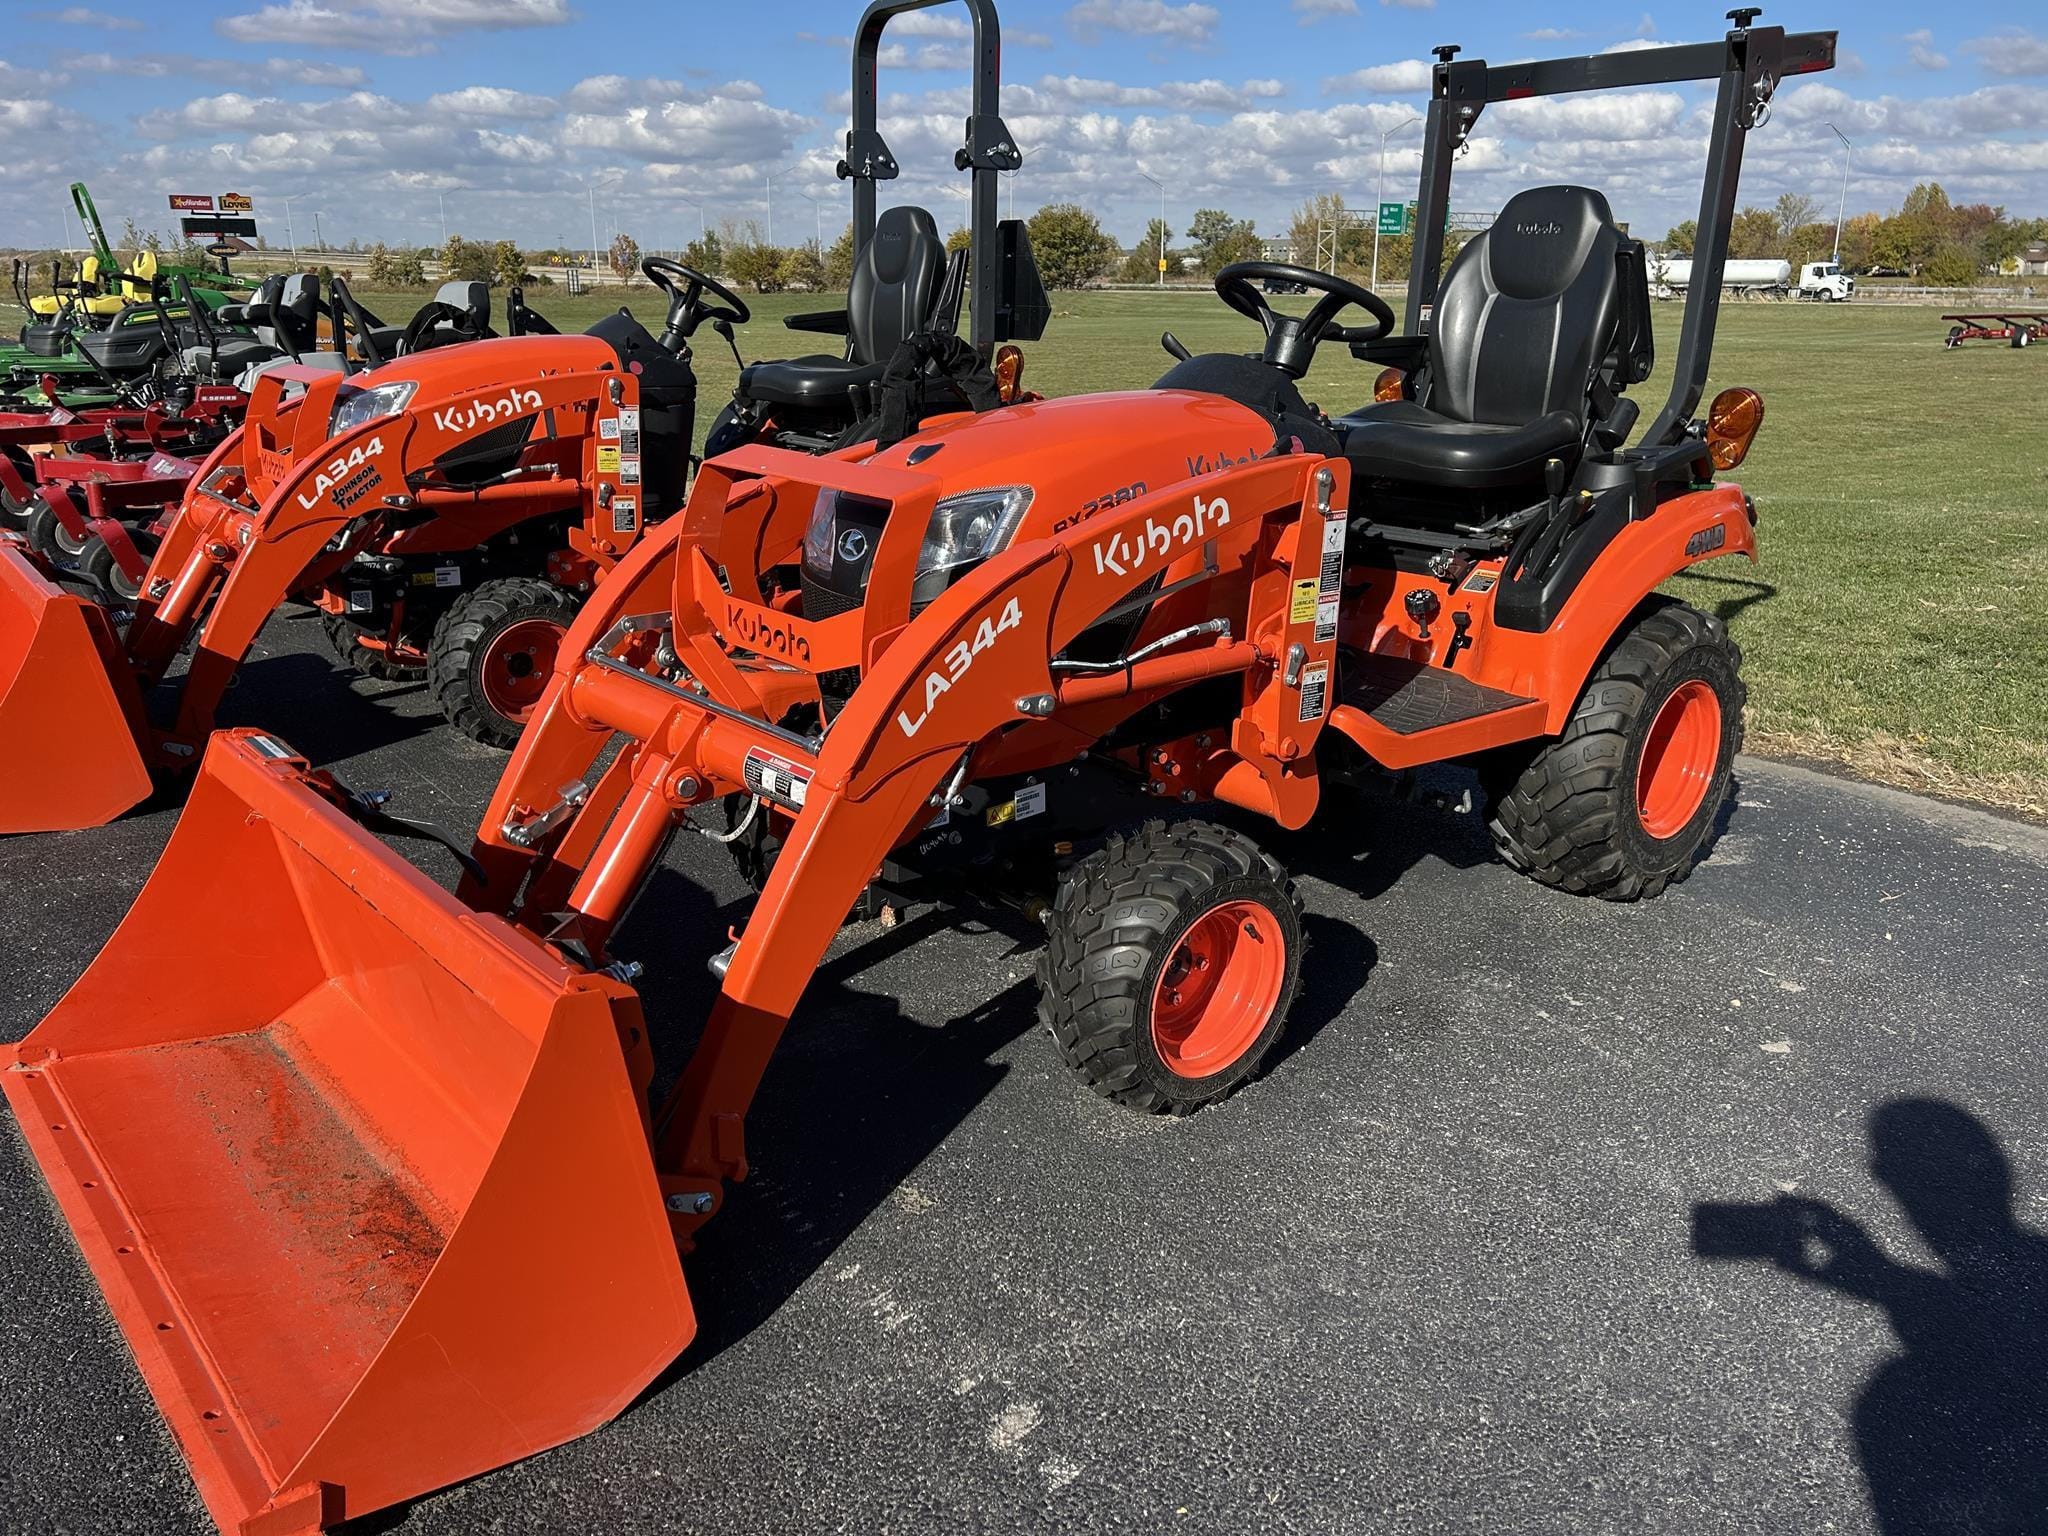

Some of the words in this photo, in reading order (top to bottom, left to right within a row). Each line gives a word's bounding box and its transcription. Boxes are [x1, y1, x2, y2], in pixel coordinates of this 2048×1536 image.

[433, 388, 543, 433] Kubota
[297, 437, 384, 510] LA344
[331, 465, 376, 503] JOHNSON
[336, 473, 383, 511] TRACTOR
[1093, 495, 1231, 576] Kubota
[1685, 522, 1726, 557] 4WD
[727, 603, 811, 664] Kubota
[897, 596, 1023, 737] LA344
